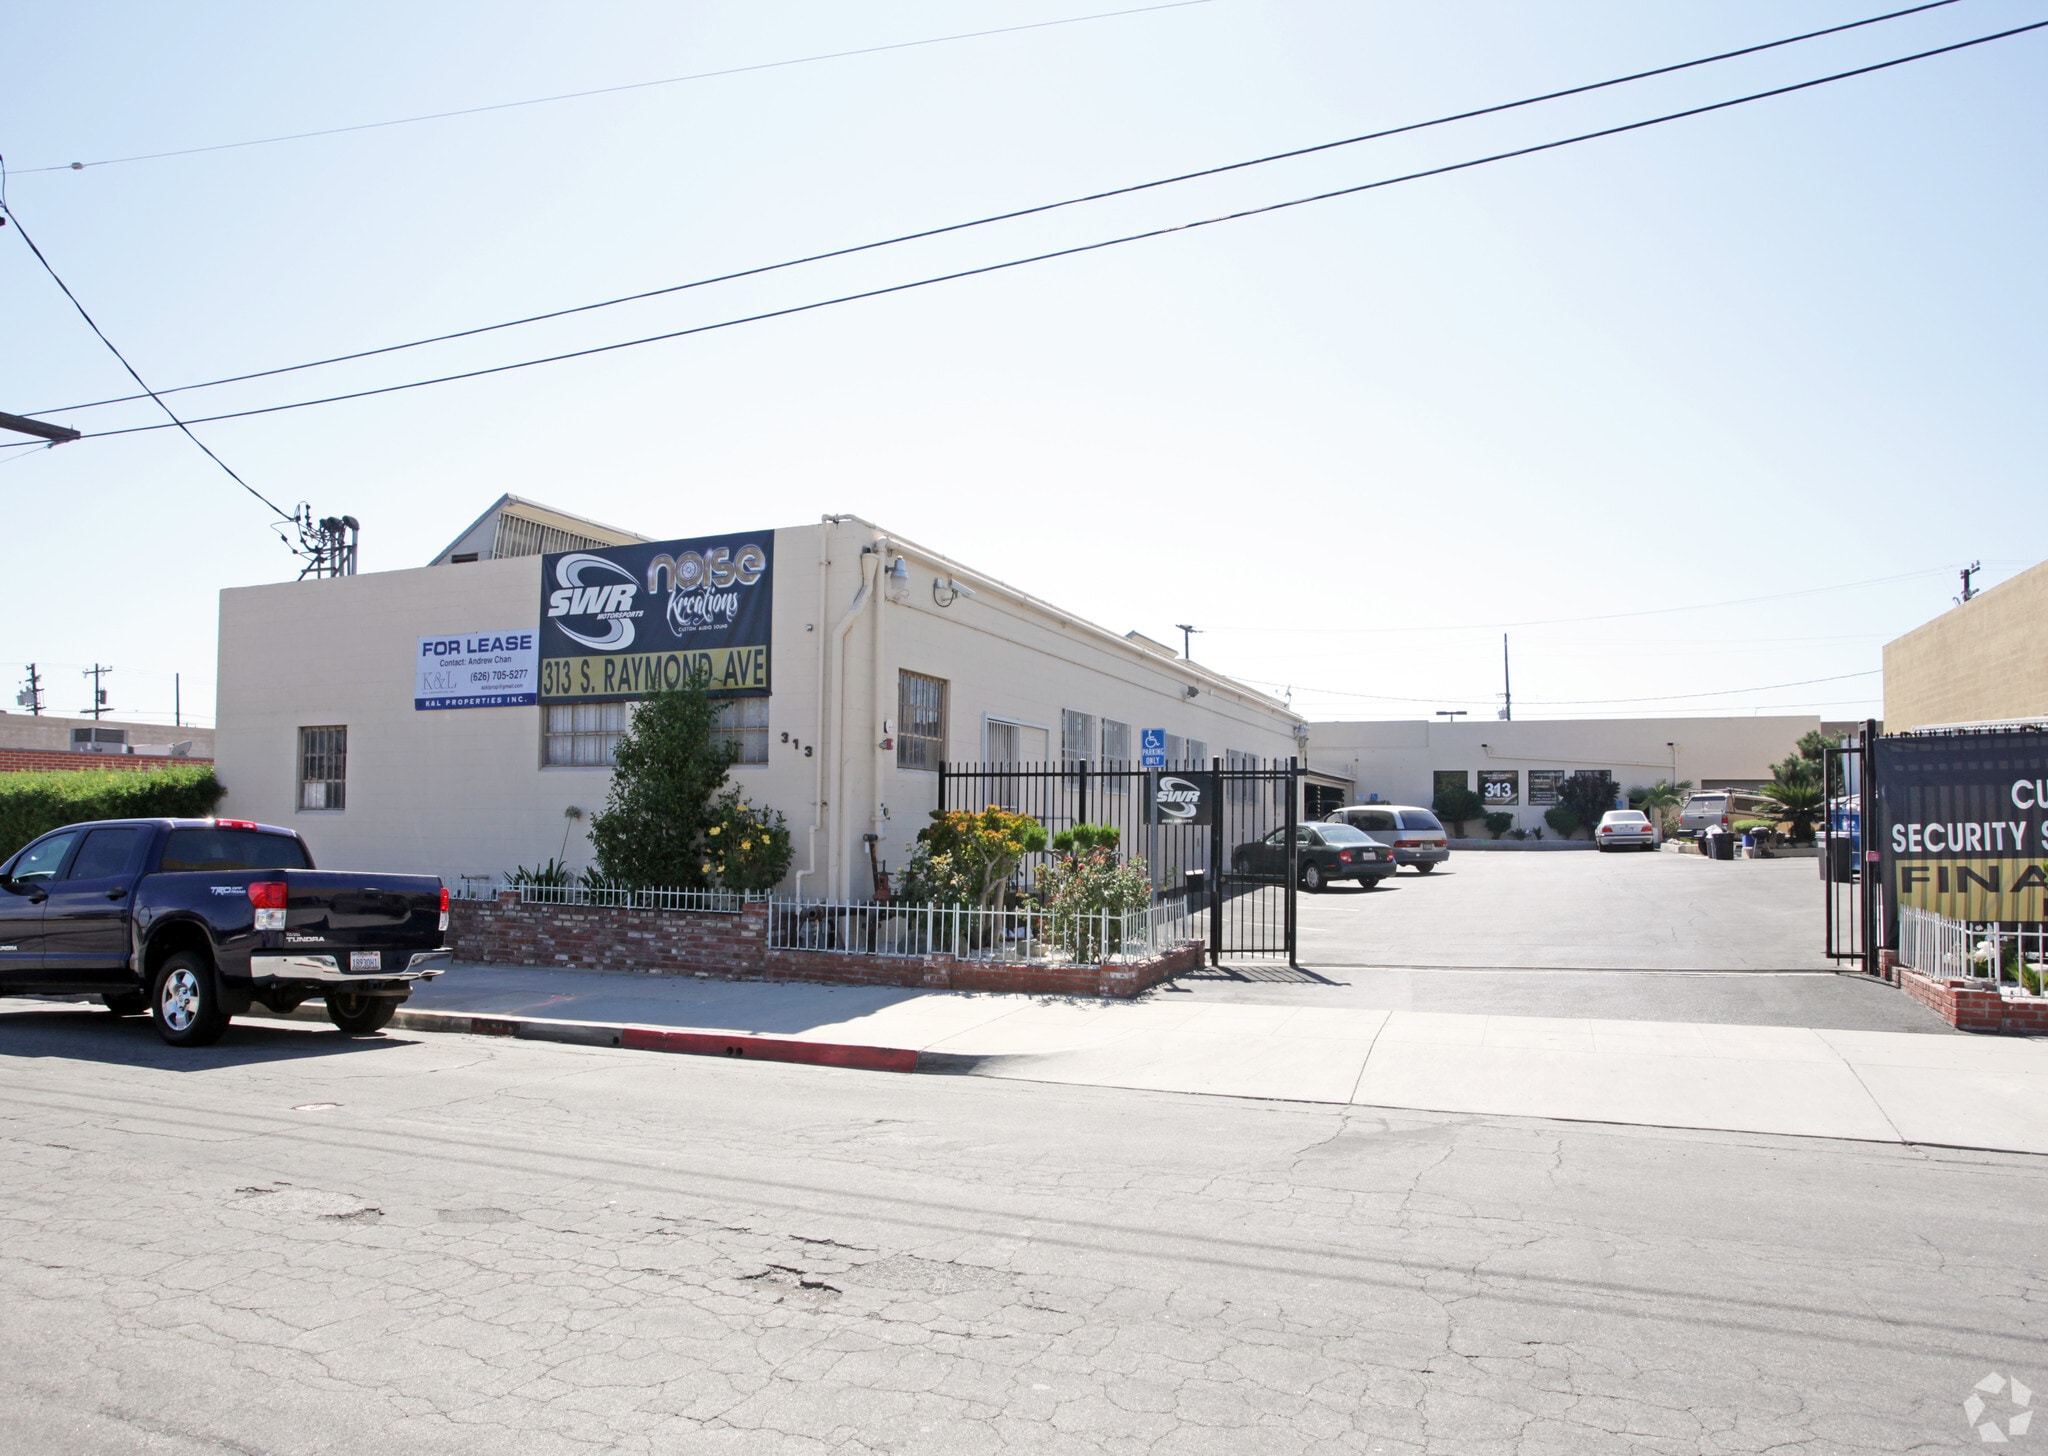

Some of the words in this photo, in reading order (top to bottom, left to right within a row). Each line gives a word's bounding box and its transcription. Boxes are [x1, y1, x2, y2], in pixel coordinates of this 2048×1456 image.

[547, 583, 637, 617] SWR
[596, 610, 645, 620] MOTORSPORTS
[422, 640, 461, 657] FOR
[467, 635, 532, 654] LEASE
[440, 659, 466, 667] Contact:
[468, 657, 492, 665] Andrew
[494, 655, 512, 664] Chan
[470, 672, 490, 683] (626)
[492, 669, 528, 680] 705-5277
[543, 660, 572, 695] 313
[580, 659, 595, 694] S.
[604, 652, 713, 692] RAYMOND
[723, 648, 764, 687] AVE
[422, 671, 457, 690] K&L
[445, 697, 502, 706] PROPERTIES
[1142, 747, 1164, 756] PARKING
[1145, 757, 1160, 765] ONLY
[1156, 790, 1200, 802] SWR
[1484, 782, 1511, 797] 313
[1891, 821, 2027, 852] SECURITY
